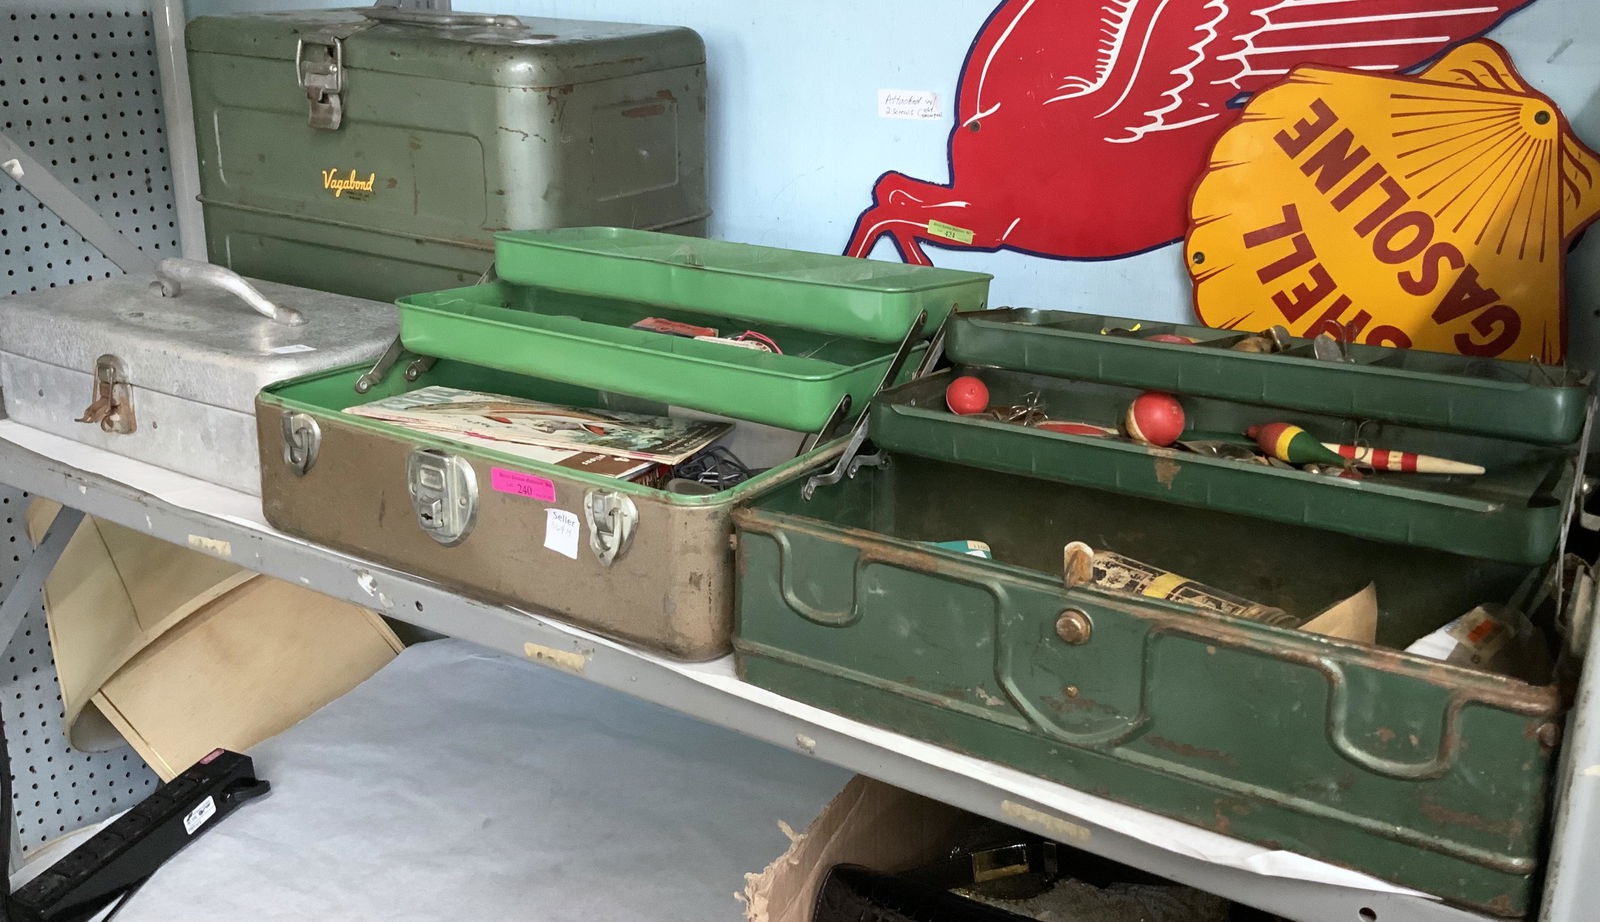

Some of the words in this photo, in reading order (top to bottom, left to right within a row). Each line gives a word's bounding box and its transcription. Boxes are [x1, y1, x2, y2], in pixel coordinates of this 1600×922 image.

[322, 168, 376, 198] Vagabond
[1273, 98, 1521, 359] GASOLINE
[517, 484, 532, 495] 240
[553, 511, 575, 527] Seller
